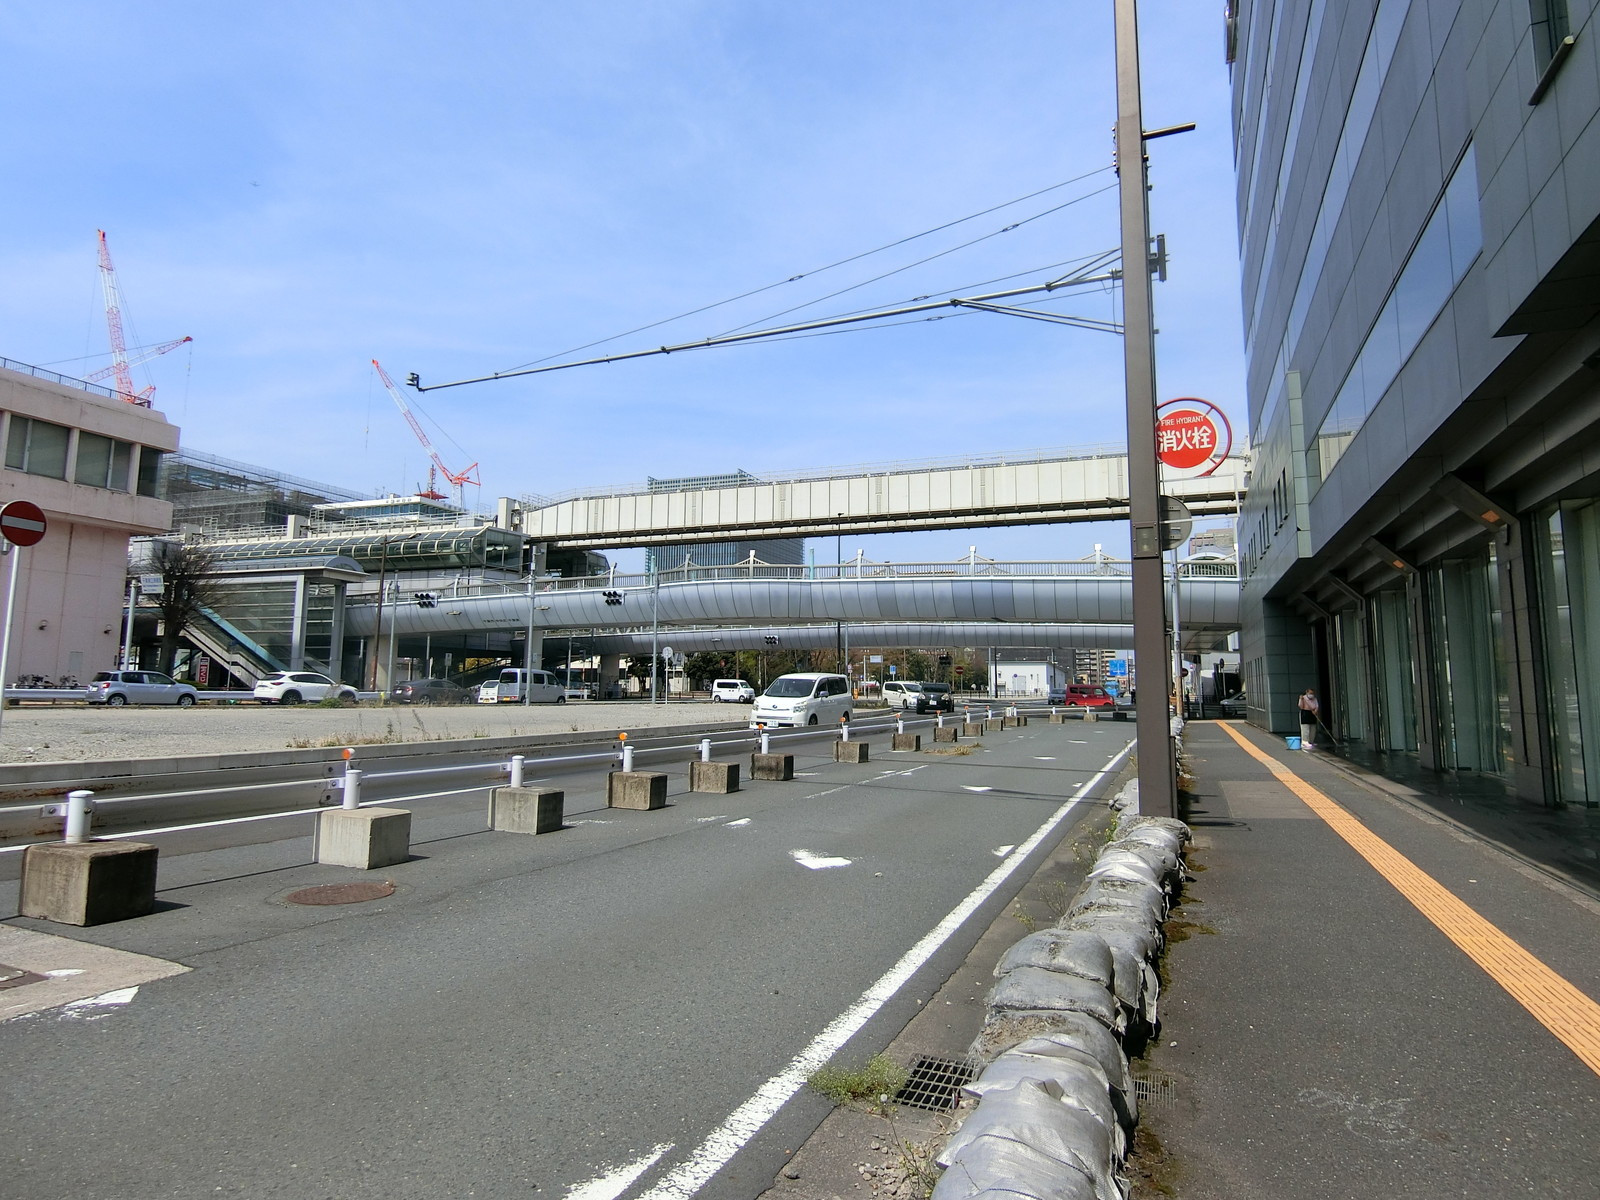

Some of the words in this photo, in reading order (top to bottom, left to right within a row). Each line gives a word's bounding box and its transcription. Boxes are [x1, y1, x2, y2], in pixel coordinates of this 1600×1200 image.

[1161, 419, 1175, 427] FIRE
[1176, 416, 1204, 425] HYDRANT
[1158, 425, 1213, 453] 消火栓
